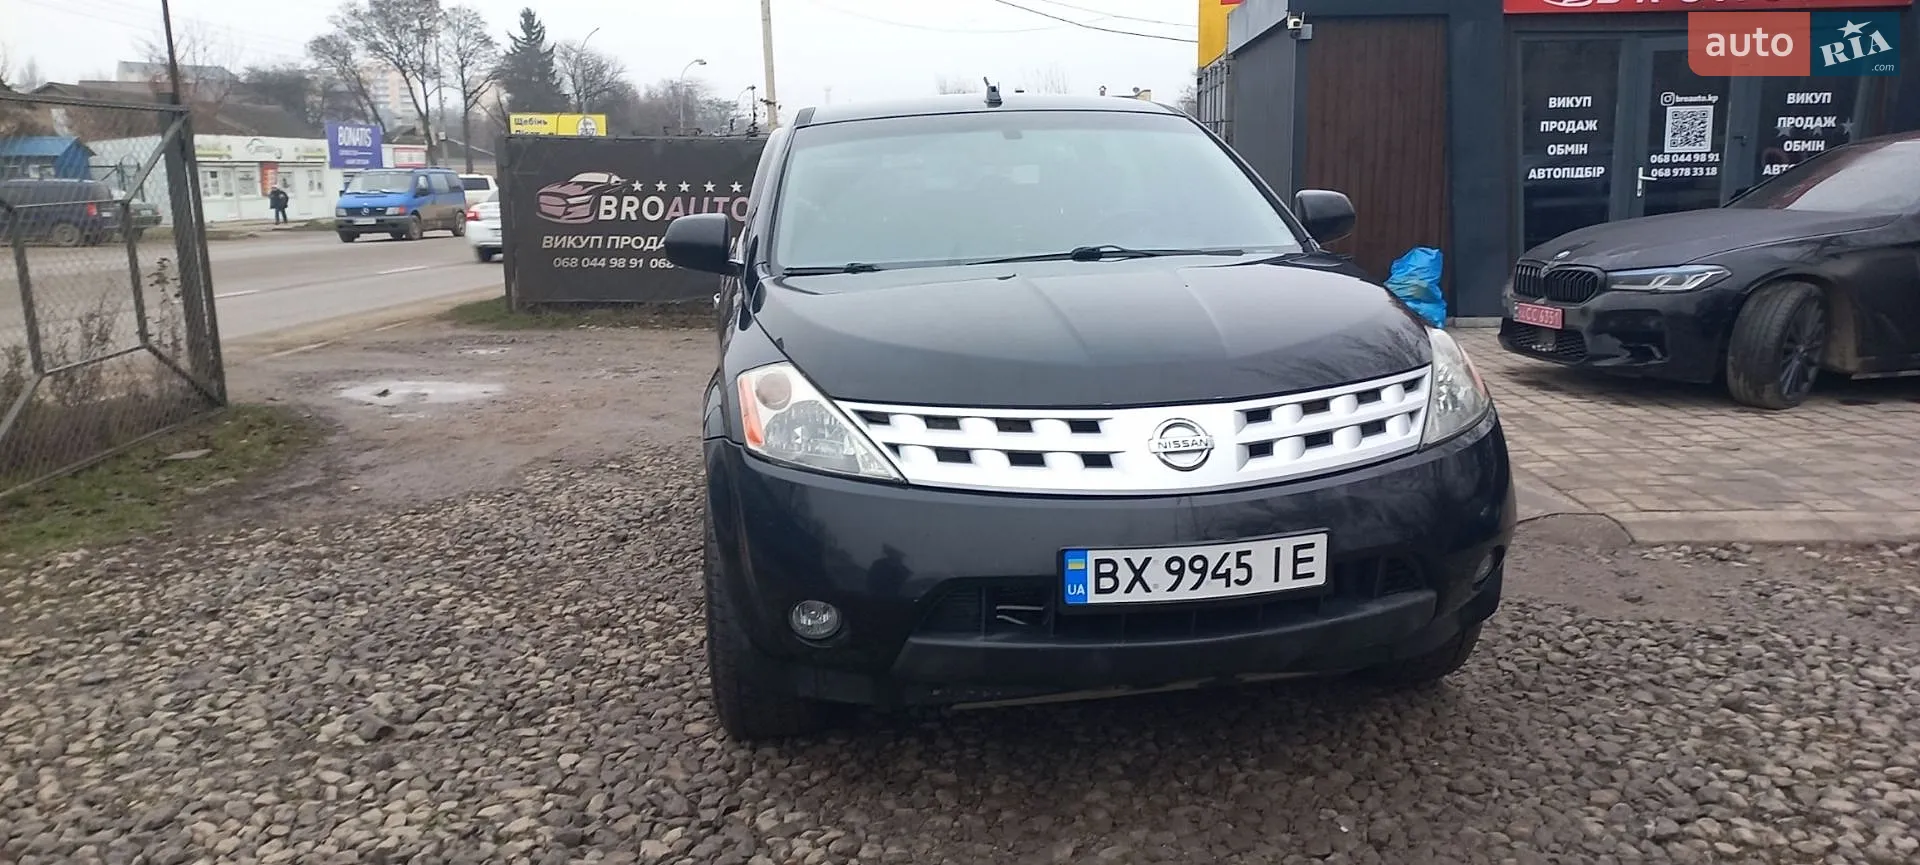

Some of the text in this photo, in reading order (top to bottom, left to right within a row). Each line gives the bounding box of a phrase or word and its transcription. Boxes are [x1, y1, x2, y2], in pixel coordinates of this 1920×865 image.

[1548, 96, 1592, 109] ВИКУП
[1786, 92, 1833, 104] ВИКУП
[1540, 120, 1598, 134] ПРОДАЖ
[1777, 115, 1837, 130] ПРОДАЖ
[1547, 143, 1589, 156] ОБМІН
[1783, 140, 1826, 152] ОБМІН
[1650, 153, 1720, 163] 068 044 98 91
[1528, 166, 1605, 179] АВТОПІДБІР
[1651, 166, 1718, 177] 068 978 33 18
[541, 235, 604, 249] ВИКУП
[553, 258, 578, 268] 068
[581, 258, 606, 268] 044
[609, 257, 627, 268] 98
[628, 257, 644, 268] 91
[1157, 438, 1208, 449] NISSAN
[1094, 542, 1316, 595] BX 9945 IE
[1067, 584, 1086, 596] UA
